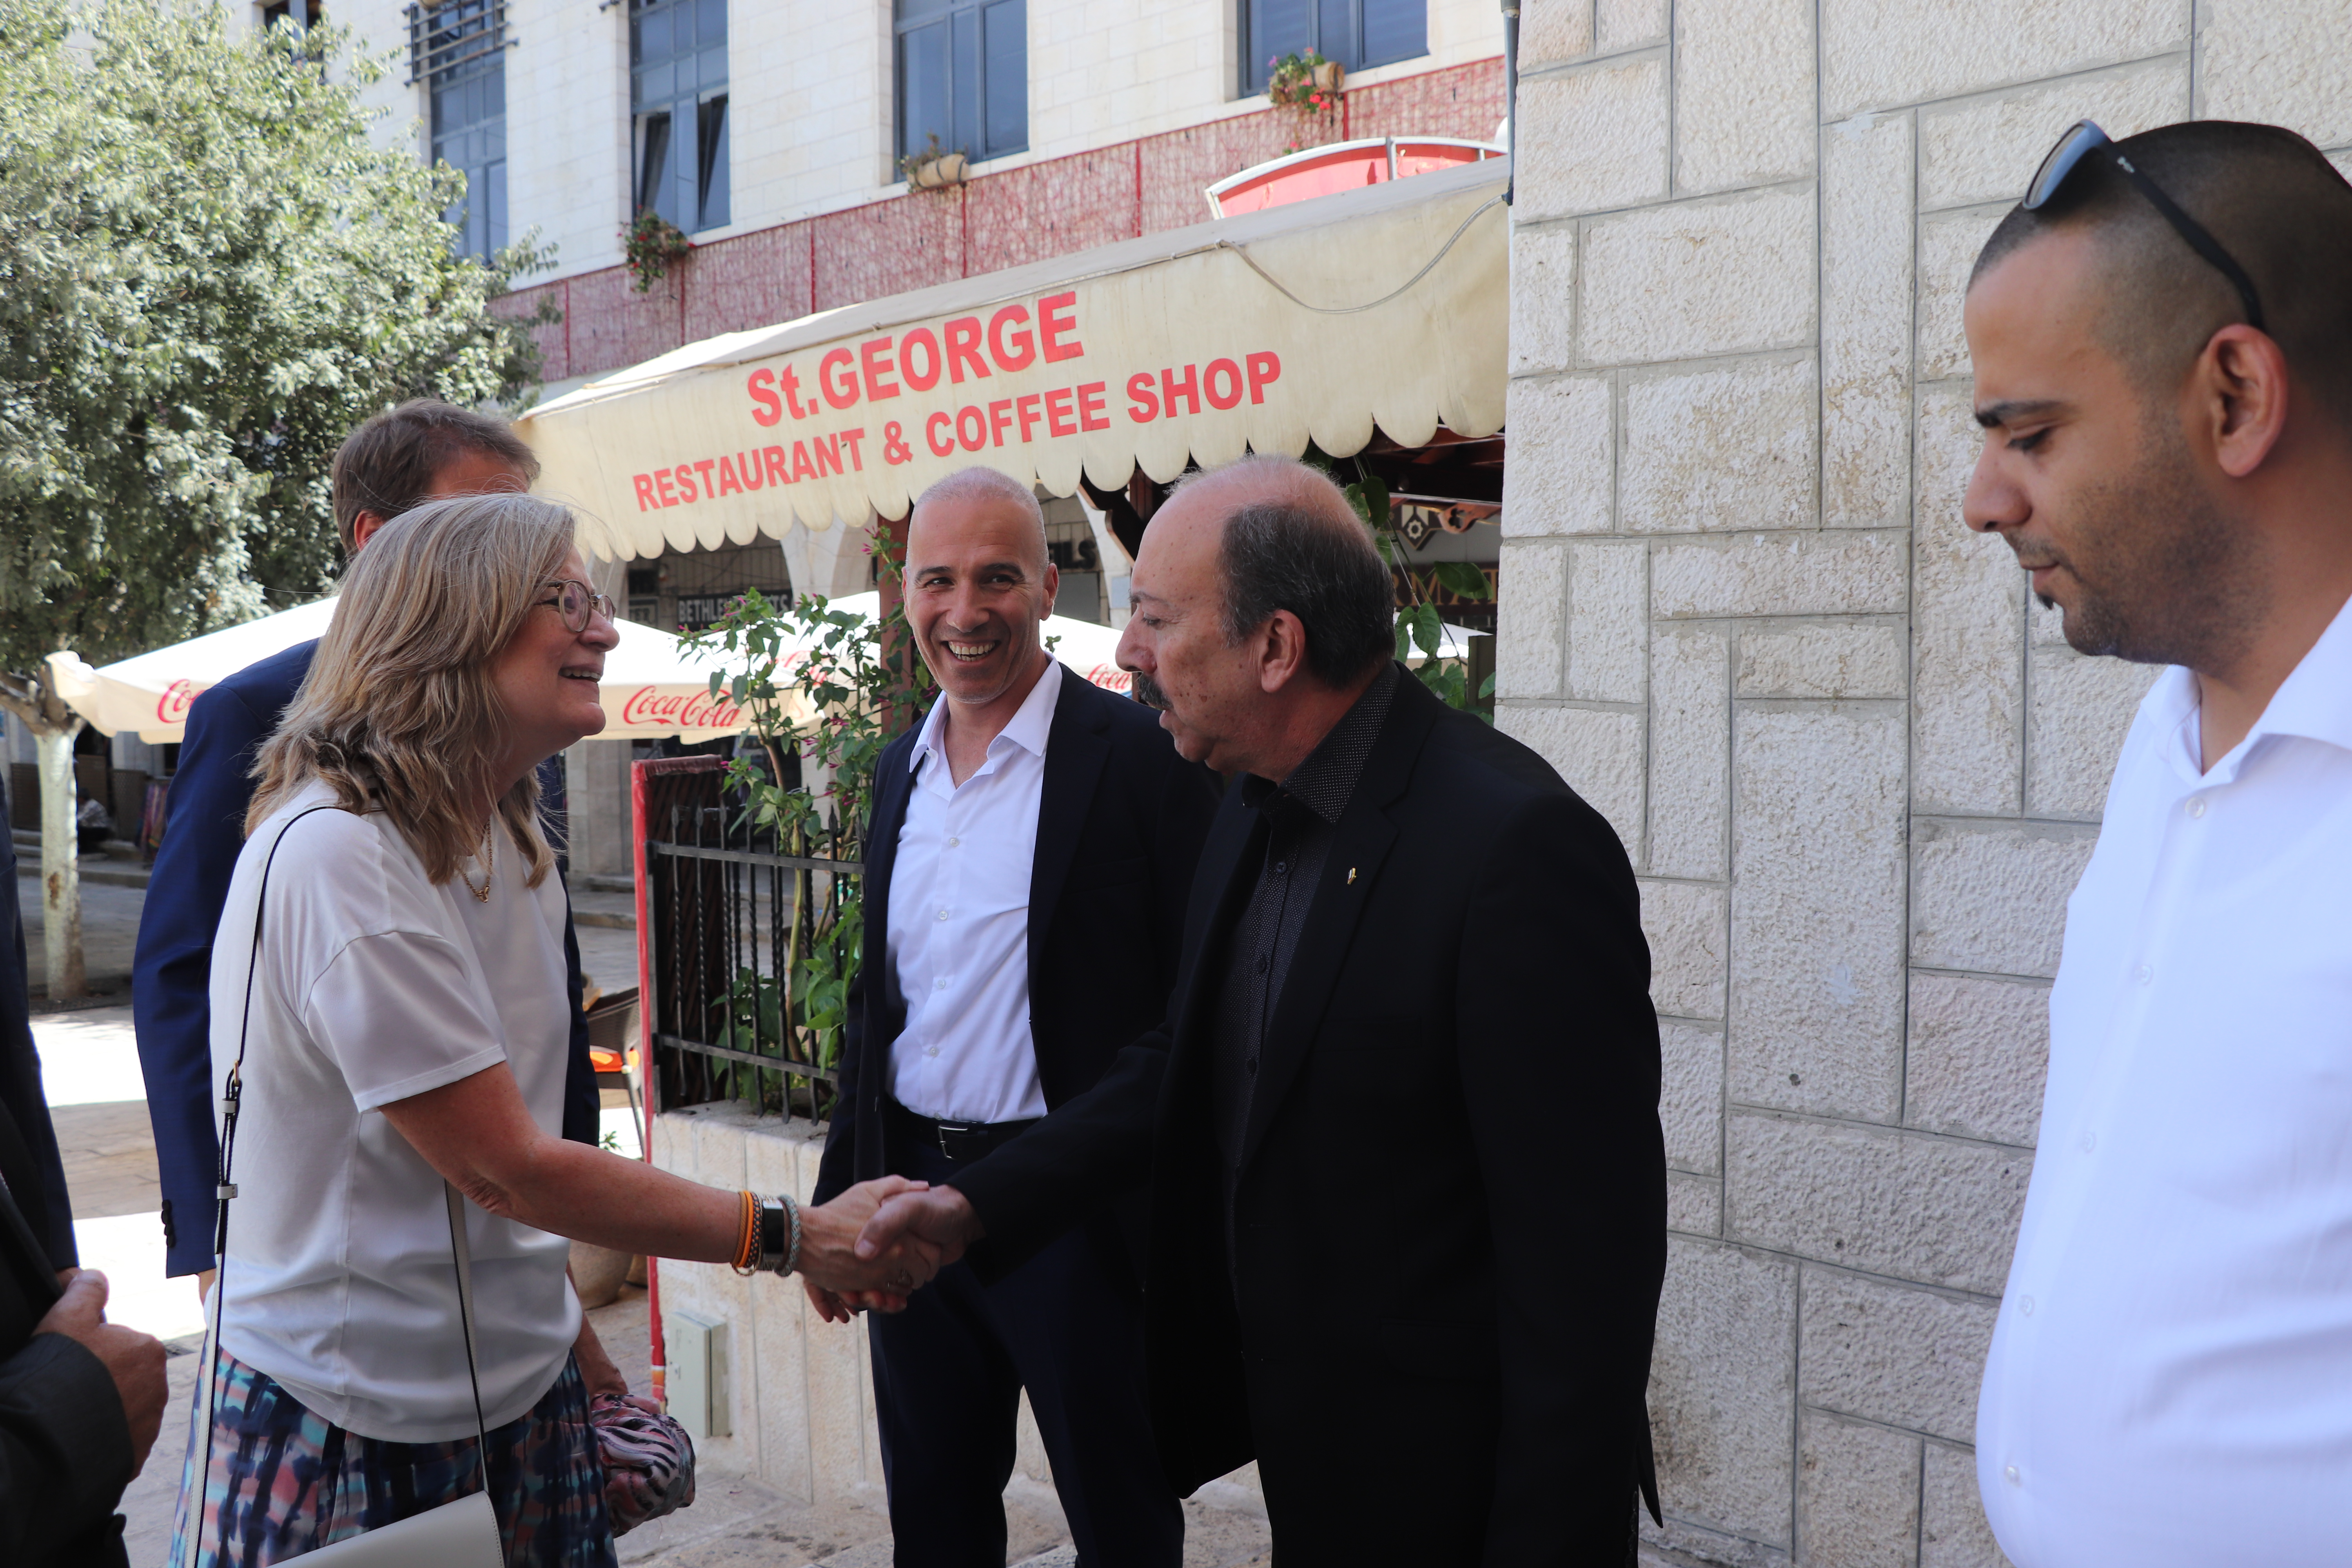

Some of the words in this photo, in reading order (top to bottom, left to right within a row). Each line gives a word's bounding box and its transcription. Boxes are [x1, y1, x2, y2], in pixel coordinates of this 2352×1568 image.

[633, 428, 864, 512] RESTAURANT
[884, 421, 913, 465] &
[926, 381, 1110, 457] COFFEE
[1127, 351, 1281, 423] SHOP
[679, 597, 729, 622] BETHLE
